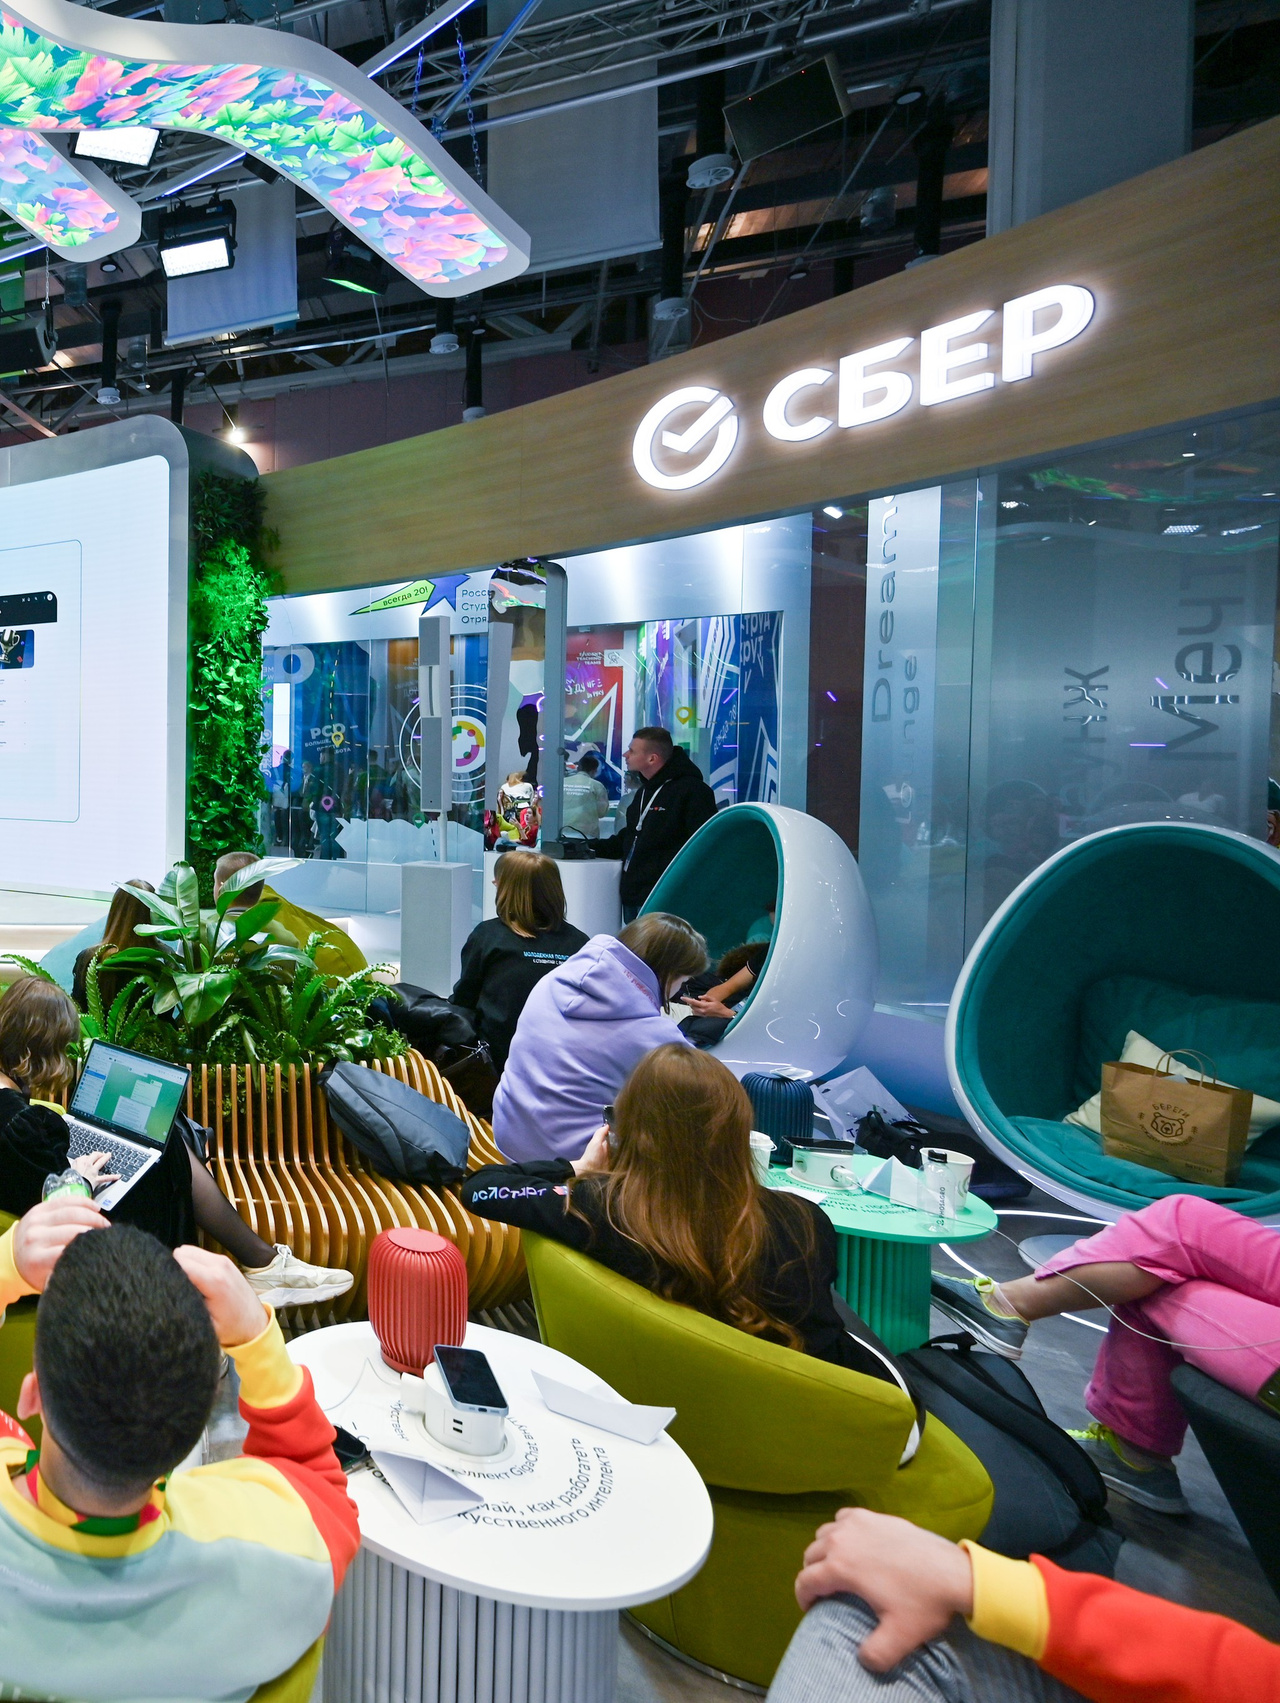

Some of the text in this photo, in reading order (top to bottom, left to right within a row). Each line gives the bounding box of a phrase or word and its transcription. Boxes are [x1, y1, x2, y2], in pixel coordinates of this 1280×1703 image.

[762, 284, 1095, 442] СБЕР
[382, 586, 429, 606] всегда 20!
[461, 615, 489, 625] Отря
[1152, 1103, 1190, 1118] БЕРЕГИ
[509, 1440, 539, 1477] GigaChat
[526, 1499, 561, 1514] как
[559, 1438, 593, 1507] разбогатеть
[587, 1446, 614, 1512] интеллекта
